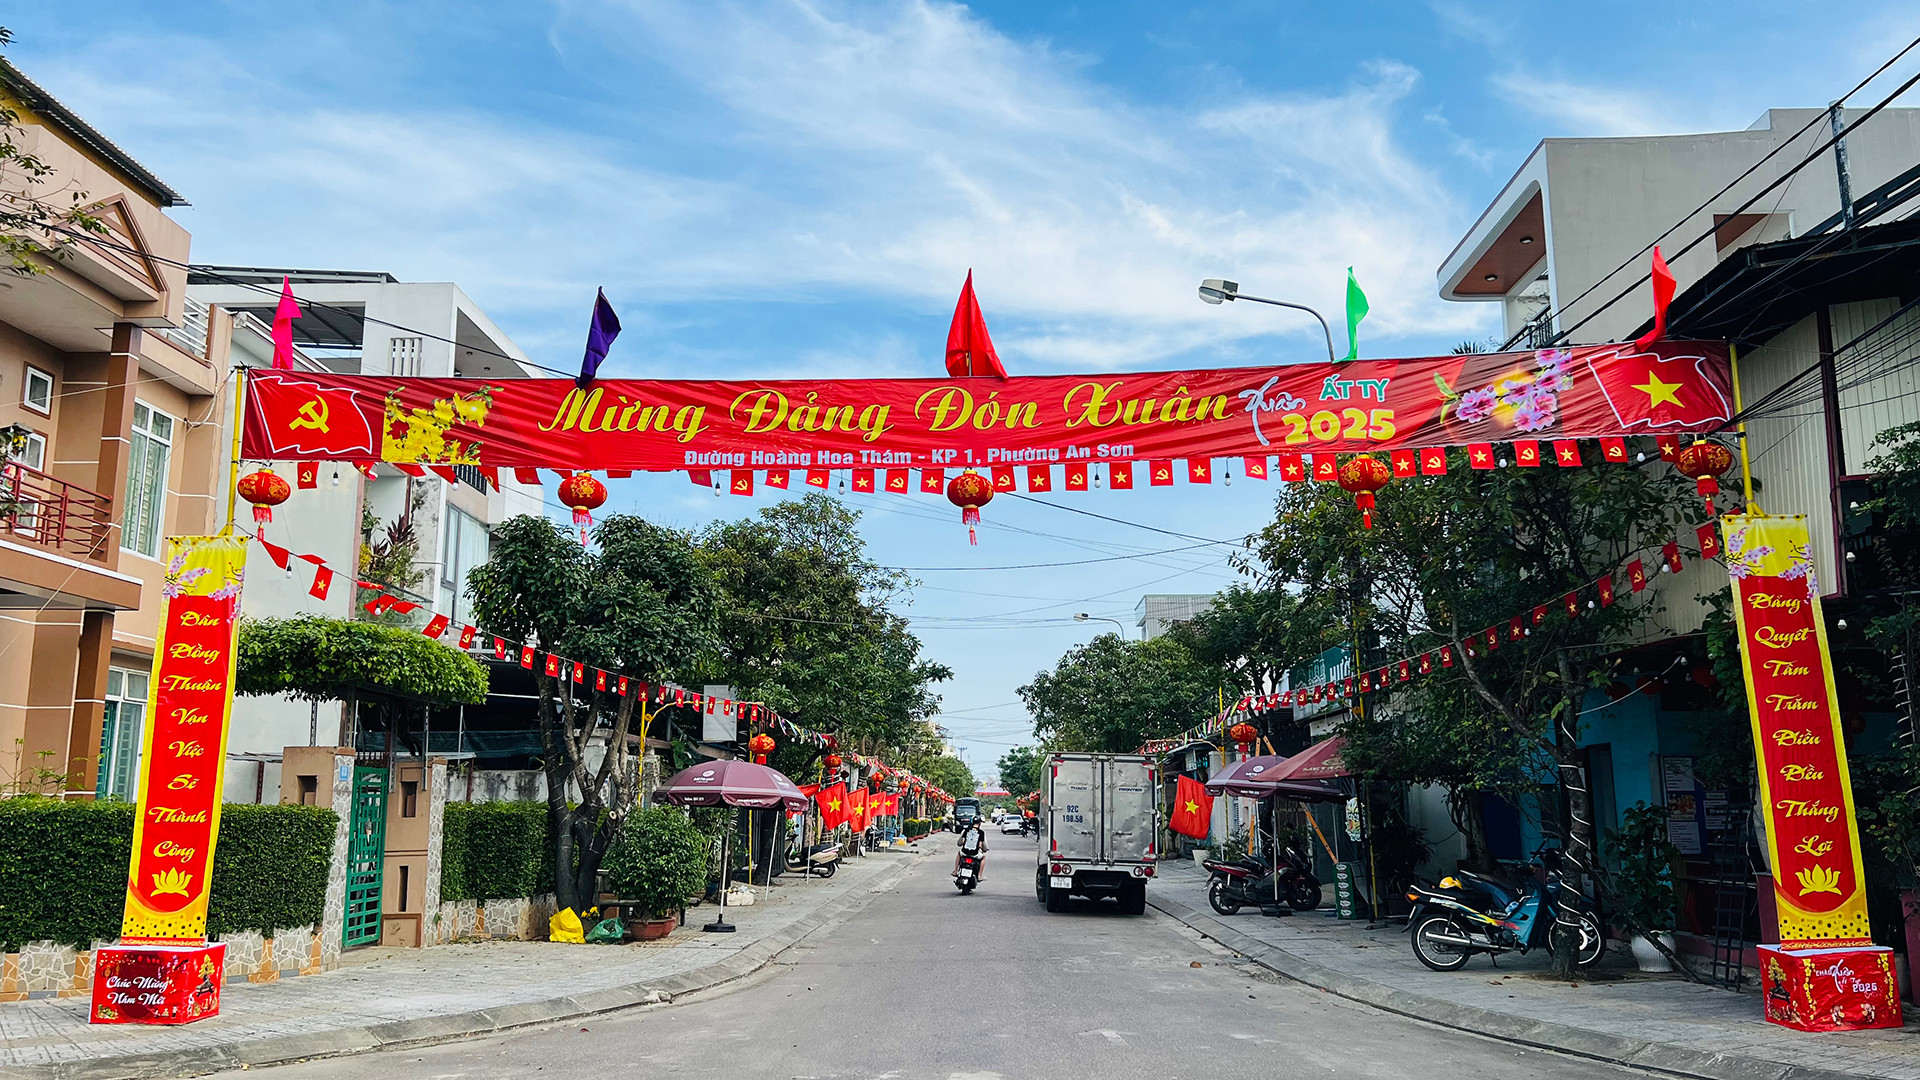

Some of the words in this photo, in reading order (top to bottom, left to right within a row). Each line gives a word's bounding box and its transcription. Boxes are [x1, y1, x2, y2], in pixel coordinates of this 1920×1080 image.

[1319, 374, 1354, 400] ẤT
[1357, 378, 1390, 402] TỴ
[537, 387, 710, 443] Mừng
[729, 388, 895, 443] Đảng
[914, 386, 1043, 432] Đón
[1063, 381, 1234, 429] Xuân
[1281, 407, 1396, 445] 2025
[684, 450, 745, 466] Đường
[751, 450, 811, 466] Hoàng
[817, 451, 854, 465] Hoa
[859, 450, 912, 465] Thám
[931, 449, 958, 464] KP
[964, 449, 981, 465] 1,
[987, 446, 1060, 463] Phường
[1065, 444, 1091, 459] An
[1097, 442, 1135, 458] Sơn
[1747, 592, 1801, 614] Đảng
[1754, 625, 1816, 649] Quyết
[169, 643, 221, 665] Đồng
[1763, 659, 1810, 677] Tâm
[162, 674, 222, 693] Thuận
[1765, 693, 1819, 712] Trăm
[170, 707, 209, 725] Vạn
[1772, 728, 1821, 746] Điều
[168, 740, 205, 758] Việc
[167, 773, 200, 790] Sẽ
[1779, 763, 1824, 782] Đều
[148, 806, 207, 823] Thành
[1066, 804, 1079, 813] 92C
[1776, 799, 1840, 823] Thắng
[153, 840, 196, 863] Công
[1793, 834, 1834, 857] Lợi
[106, 976, 131, 988] Chúc
[133, 976, 168, 993] Mừng
